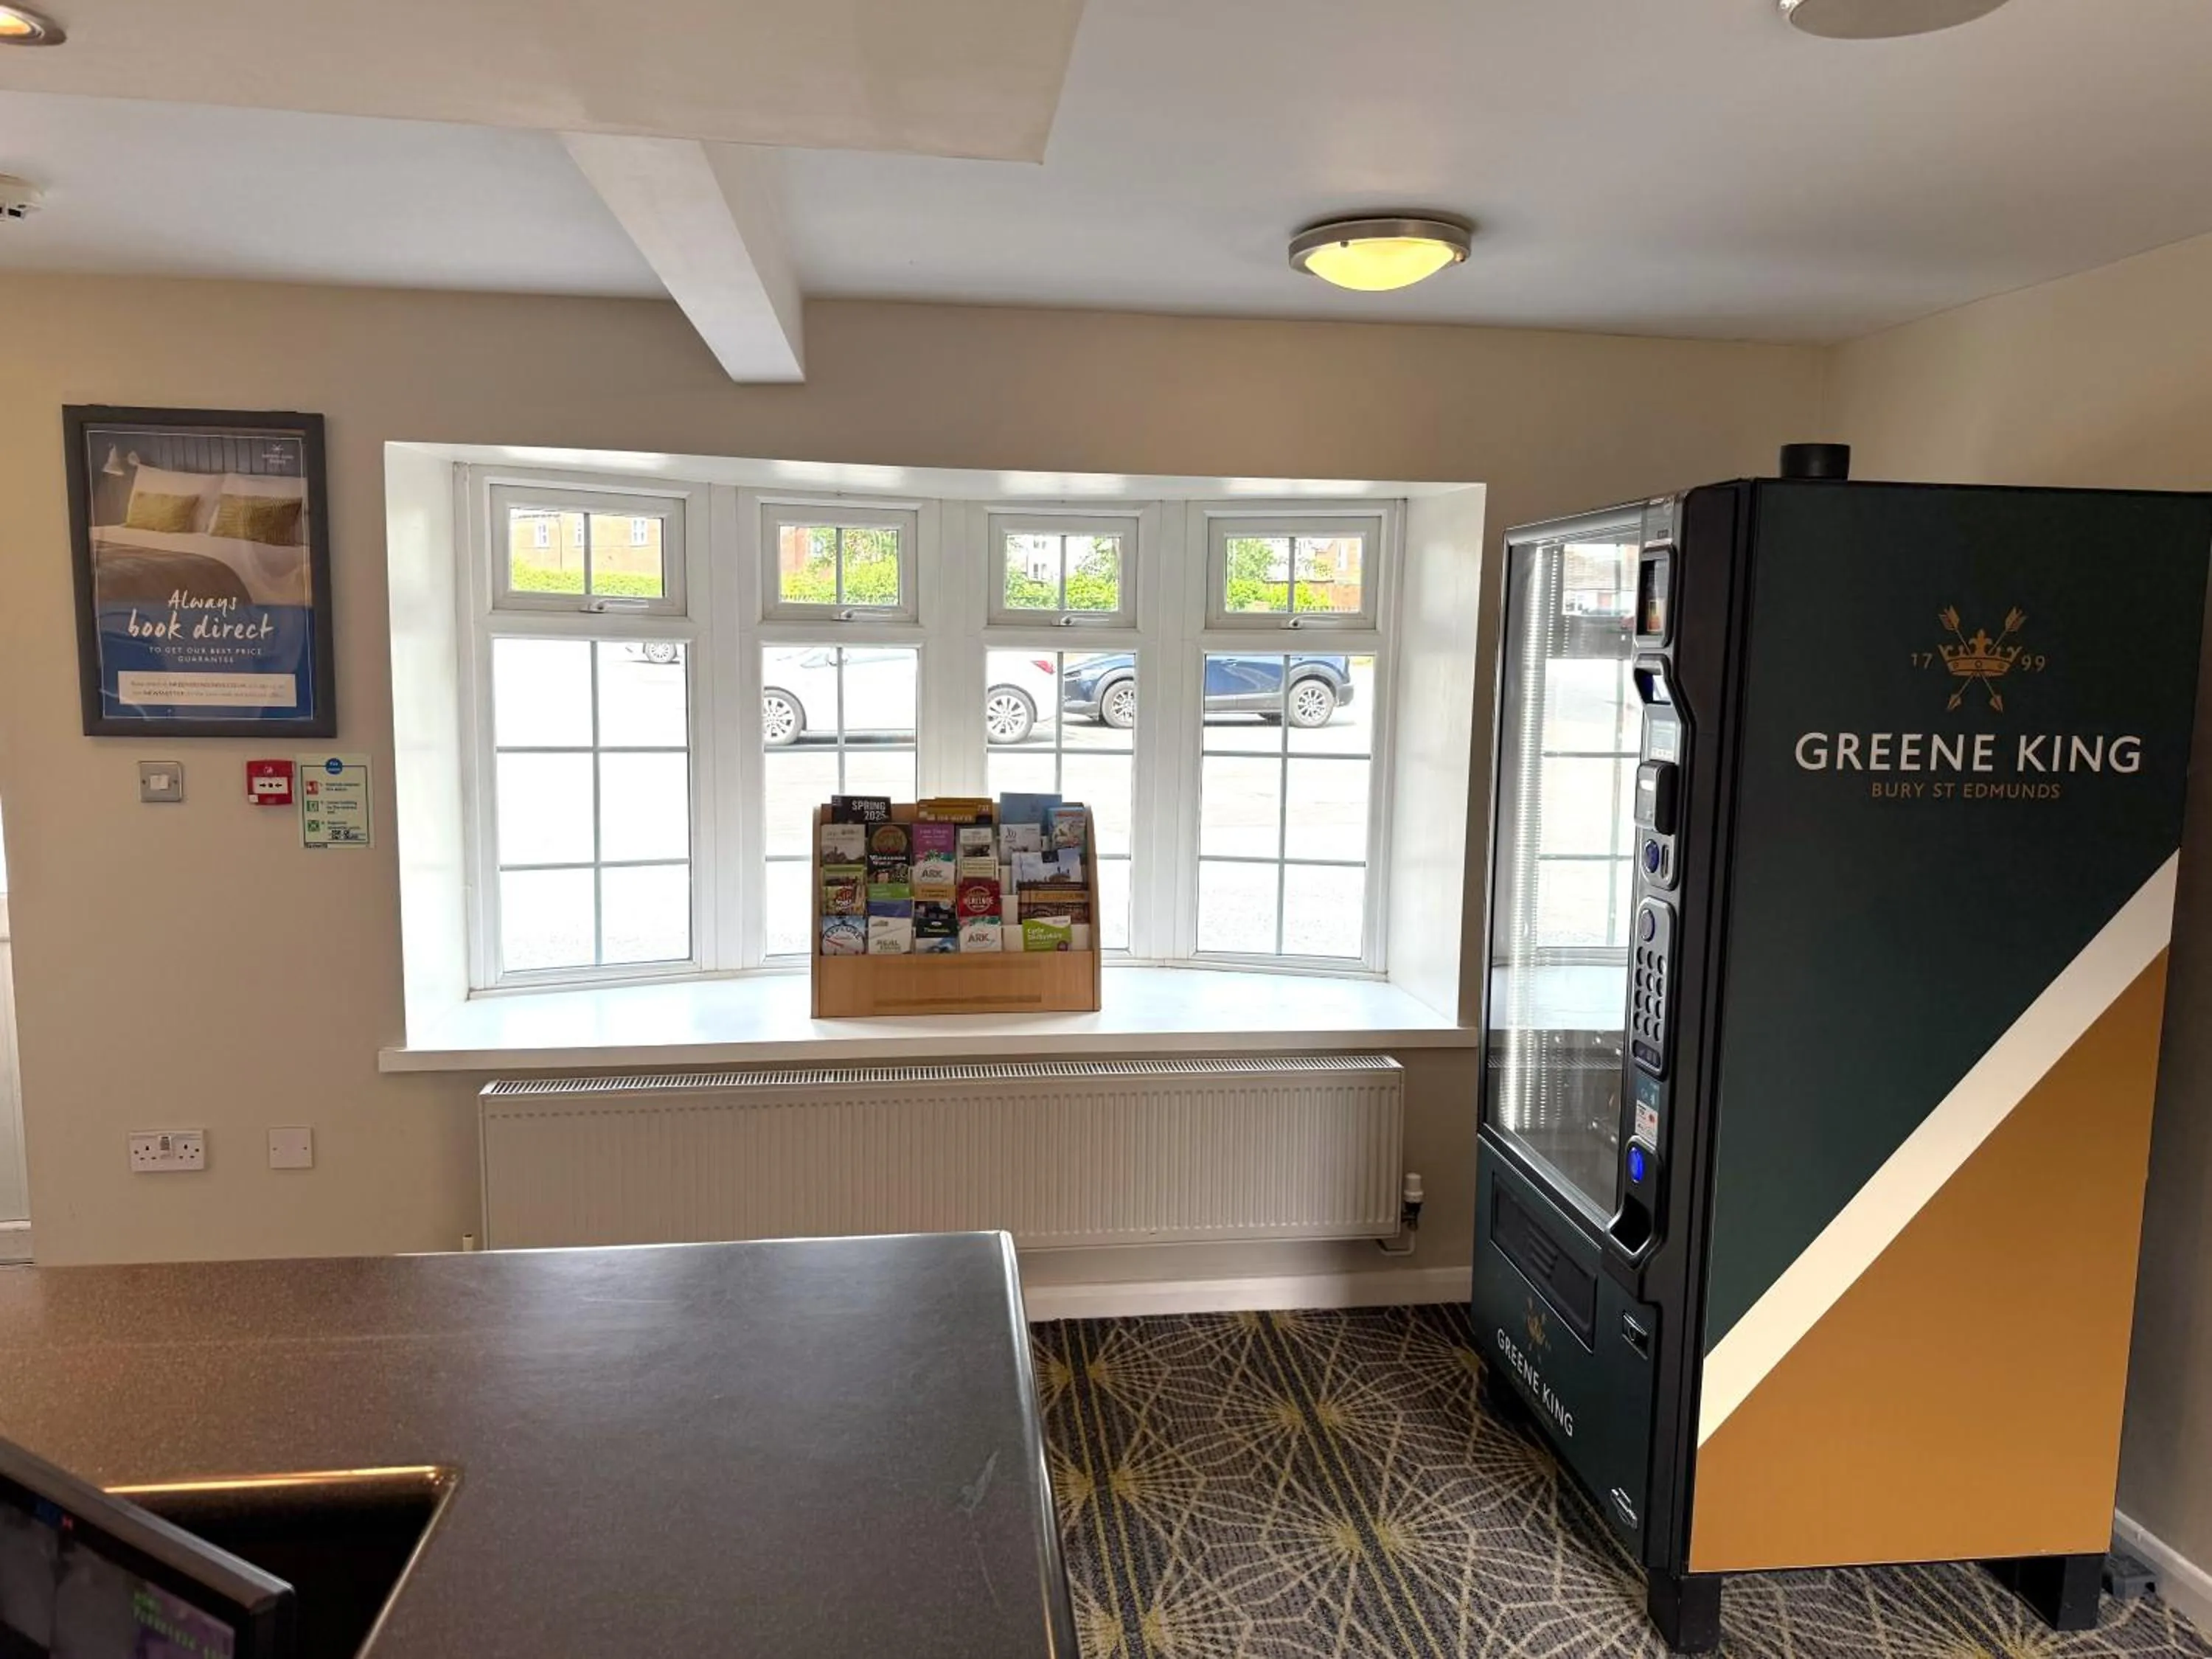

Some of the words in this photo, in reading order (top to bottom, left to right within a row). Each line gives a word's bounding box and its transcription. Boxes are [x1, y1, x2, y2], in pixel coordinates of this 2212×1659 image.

[168, 589, 237, 617] Always
[128, 608, 184, 641] book
[192, 613, 274, 640] direct
[149, 646, 161, 654] TO
[178, 655, 234, 664] GUARANTEE
[1910, 653, 1933, 669] 17
[2020, 655, 2045, 672] 99
[1795, 731, 1995, 772] GREENE
[2017, 734, 2142, 773] KING
[1871, 782, 1925, 799] BURY
[1933, 782, 1956, 799] ST
[1963, 782, 2062, 799] EDMUNDS
[852, 800, 886, 810] SPRING
[864, 810, 886, 821] 2025
[968, 932, 990, 942] ARK
[1498, 1328, 1540, 1393] GREENE
[1543, 1382, 1573, 1436] KING
